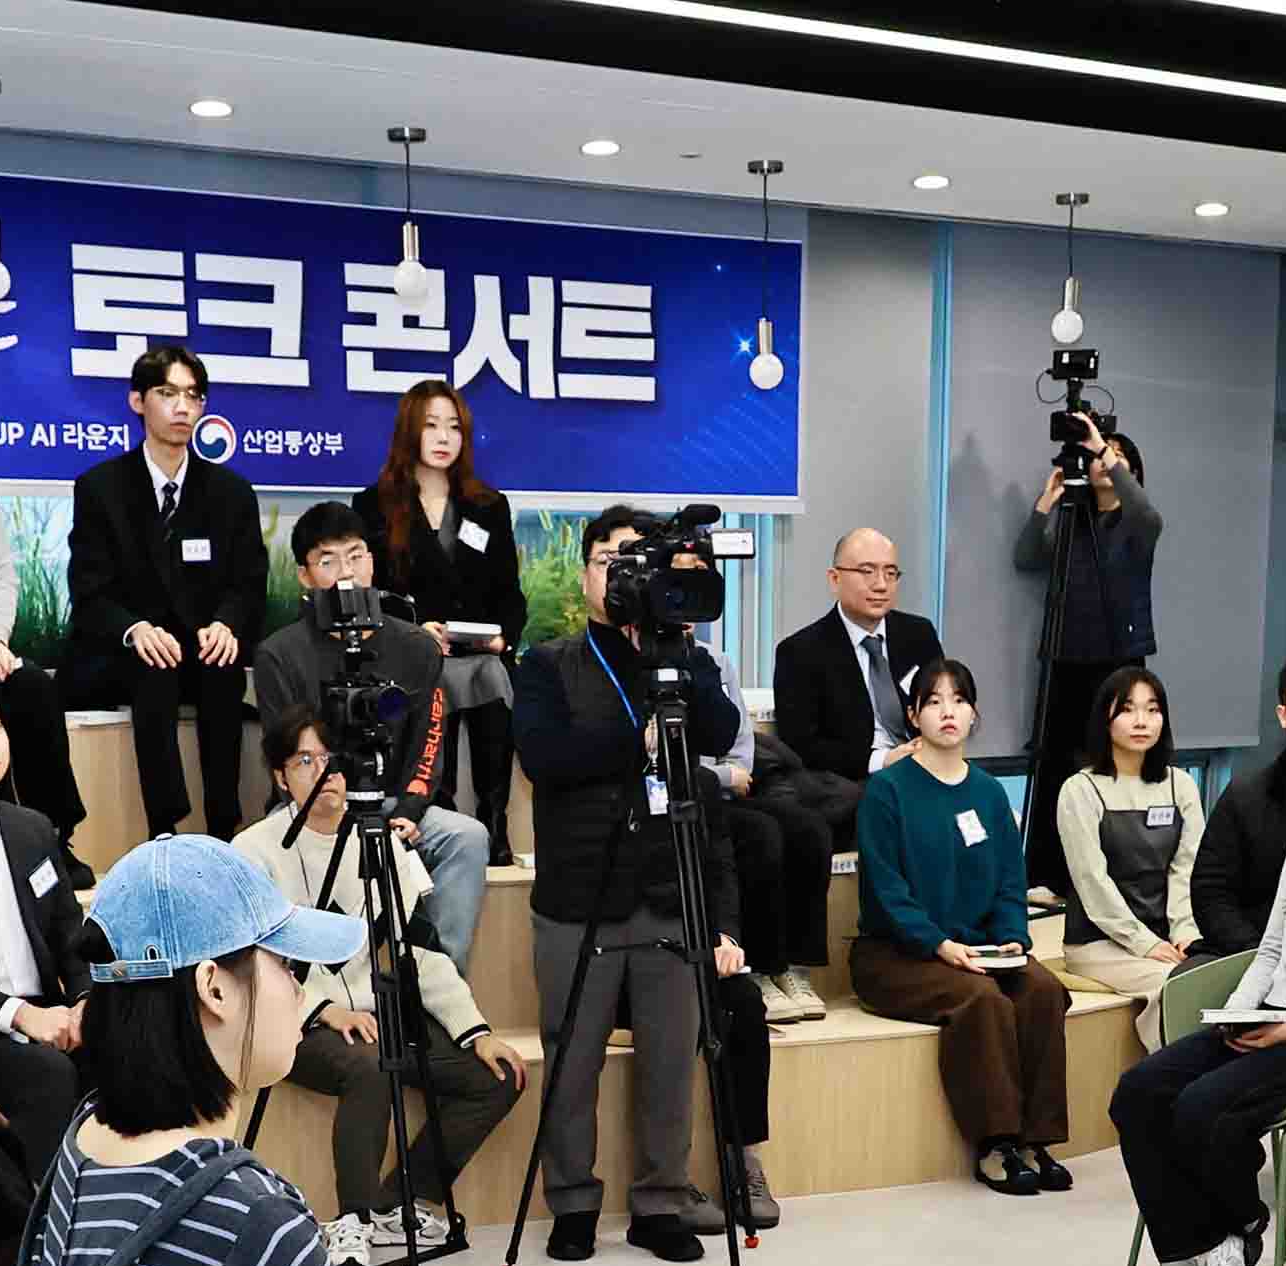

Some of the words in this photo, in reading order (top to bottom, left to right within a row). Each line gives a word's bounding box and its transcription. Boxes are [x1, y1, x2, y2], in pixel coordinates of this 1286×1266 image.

[70, 243, 310, 388] 토크
[342, 261, 656, 402] 콘서트
[31, 423, 57, 448] AI
[63, 422, 130, 452] 라운지
[242, 429, 344, 456] 산업통상부
[416, 687, 443, 780] carhartt
